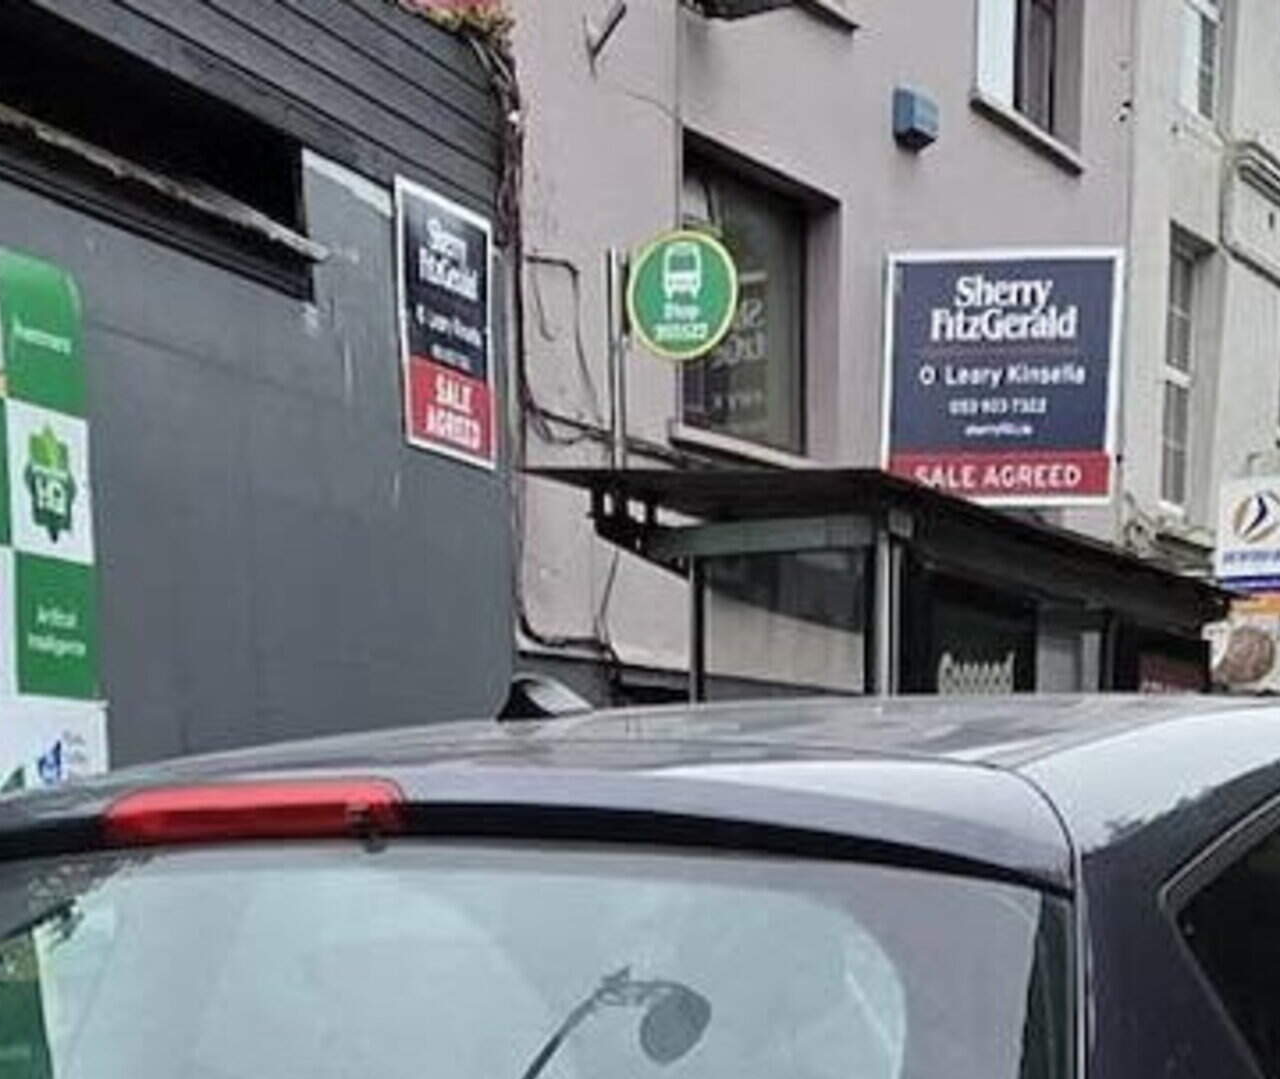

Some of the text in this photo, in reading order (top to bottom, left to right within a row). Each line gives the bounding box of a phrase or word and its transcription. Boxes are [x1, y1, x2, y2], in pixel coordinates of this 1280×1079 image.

[956, 275, 1053, 314] Sherry
[931, 305, 1079, 341] FitzGerald
[435, 373, 472, 413] SALE
[920, 363, 1087, 389] O Leary Kinsella
[425, 404, 481, 450] AGREED
[36, 475, 68, 516] HQ
[913, 463, 1083, 489] SALE AGREED
